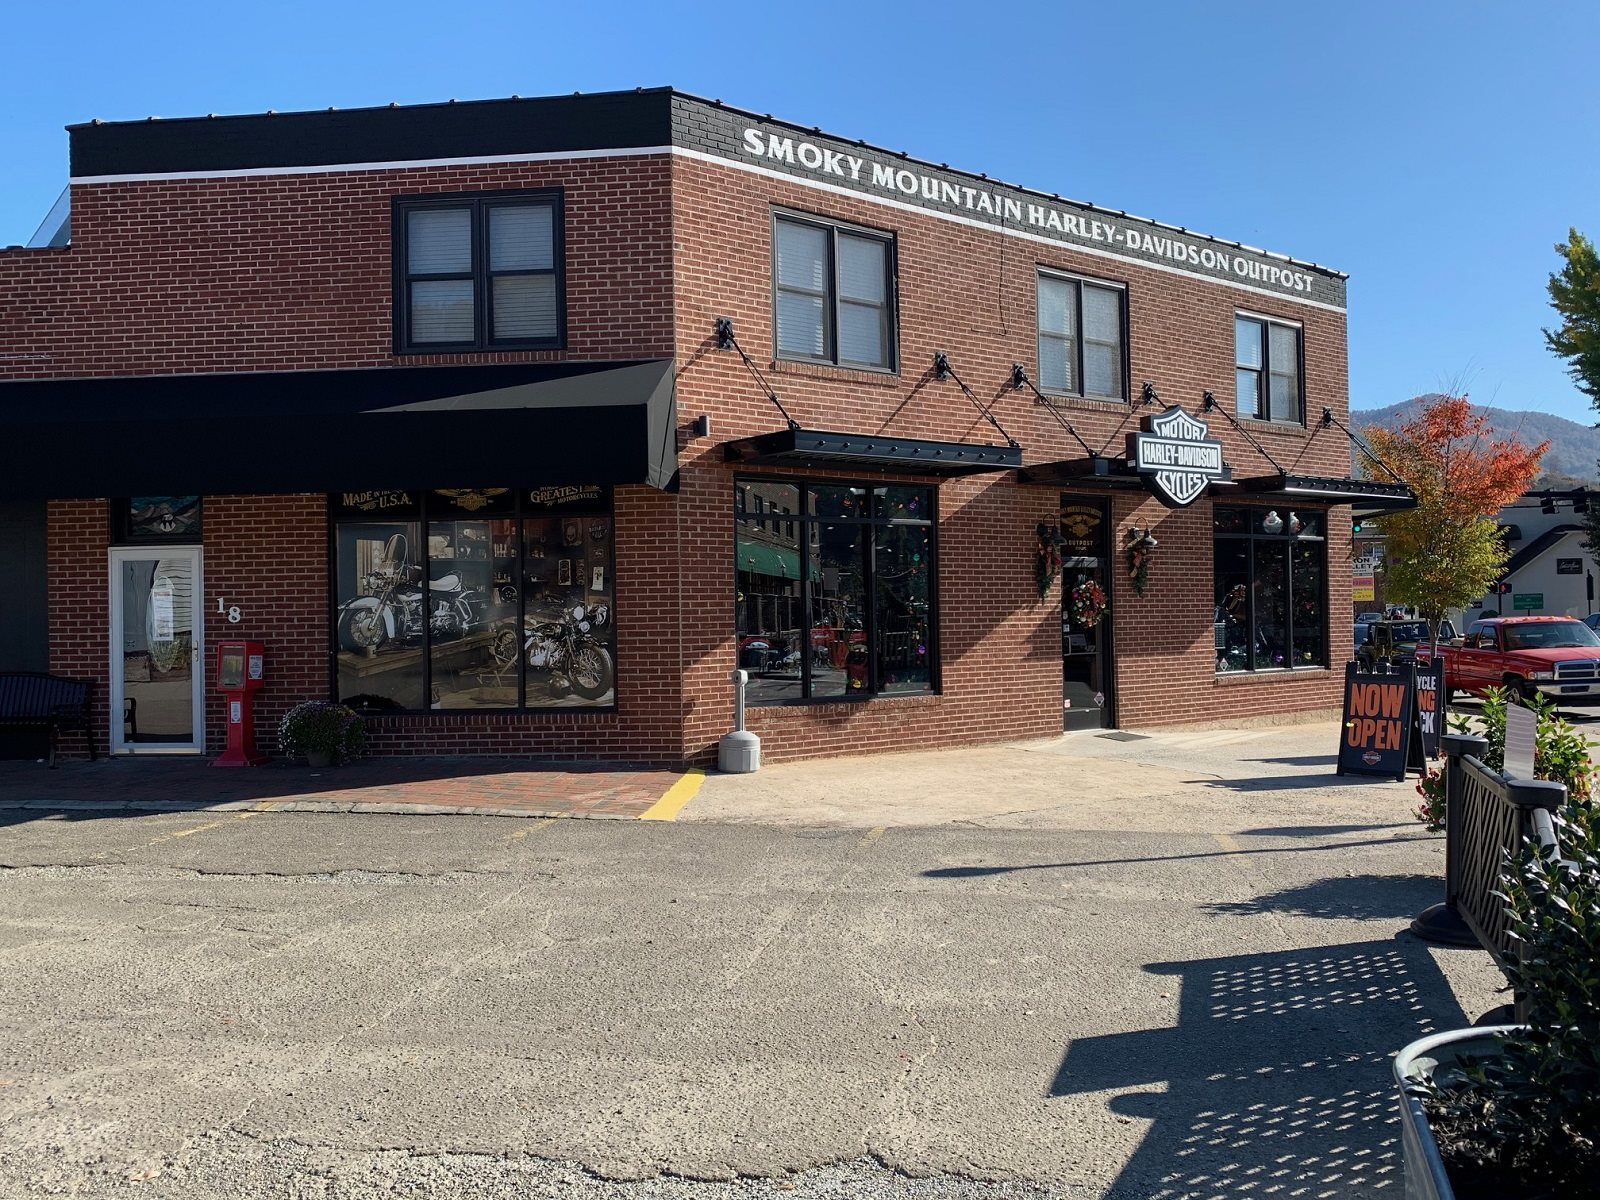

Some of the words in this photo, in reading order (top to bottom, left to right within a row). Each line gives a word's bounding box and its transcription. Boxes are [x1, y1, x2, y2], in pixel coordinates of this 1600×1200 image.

[743, 128, 863, 180] SMOKY
[872, 162, 1022, 222] MOUNTAIN
[1028, 205, 1229, 273] HARLEY-DAVIDSON
[1233, 257, 1314, 293] OUTPOST
[1160, 416, 1201, 441] MOTOR
[1143, 442, 1218, 468] HARLEY-DAVIDSON
[342, 491, 373, 506] MADE
[1162, 471, 1202, 500] CYCLES
[379, 493, 413, 508] U.S.A.
[216, 597, 241, 623] 18
[1350, 683, 1405, 718] NOW
[1347, 718, 1402, 751] OPEN
